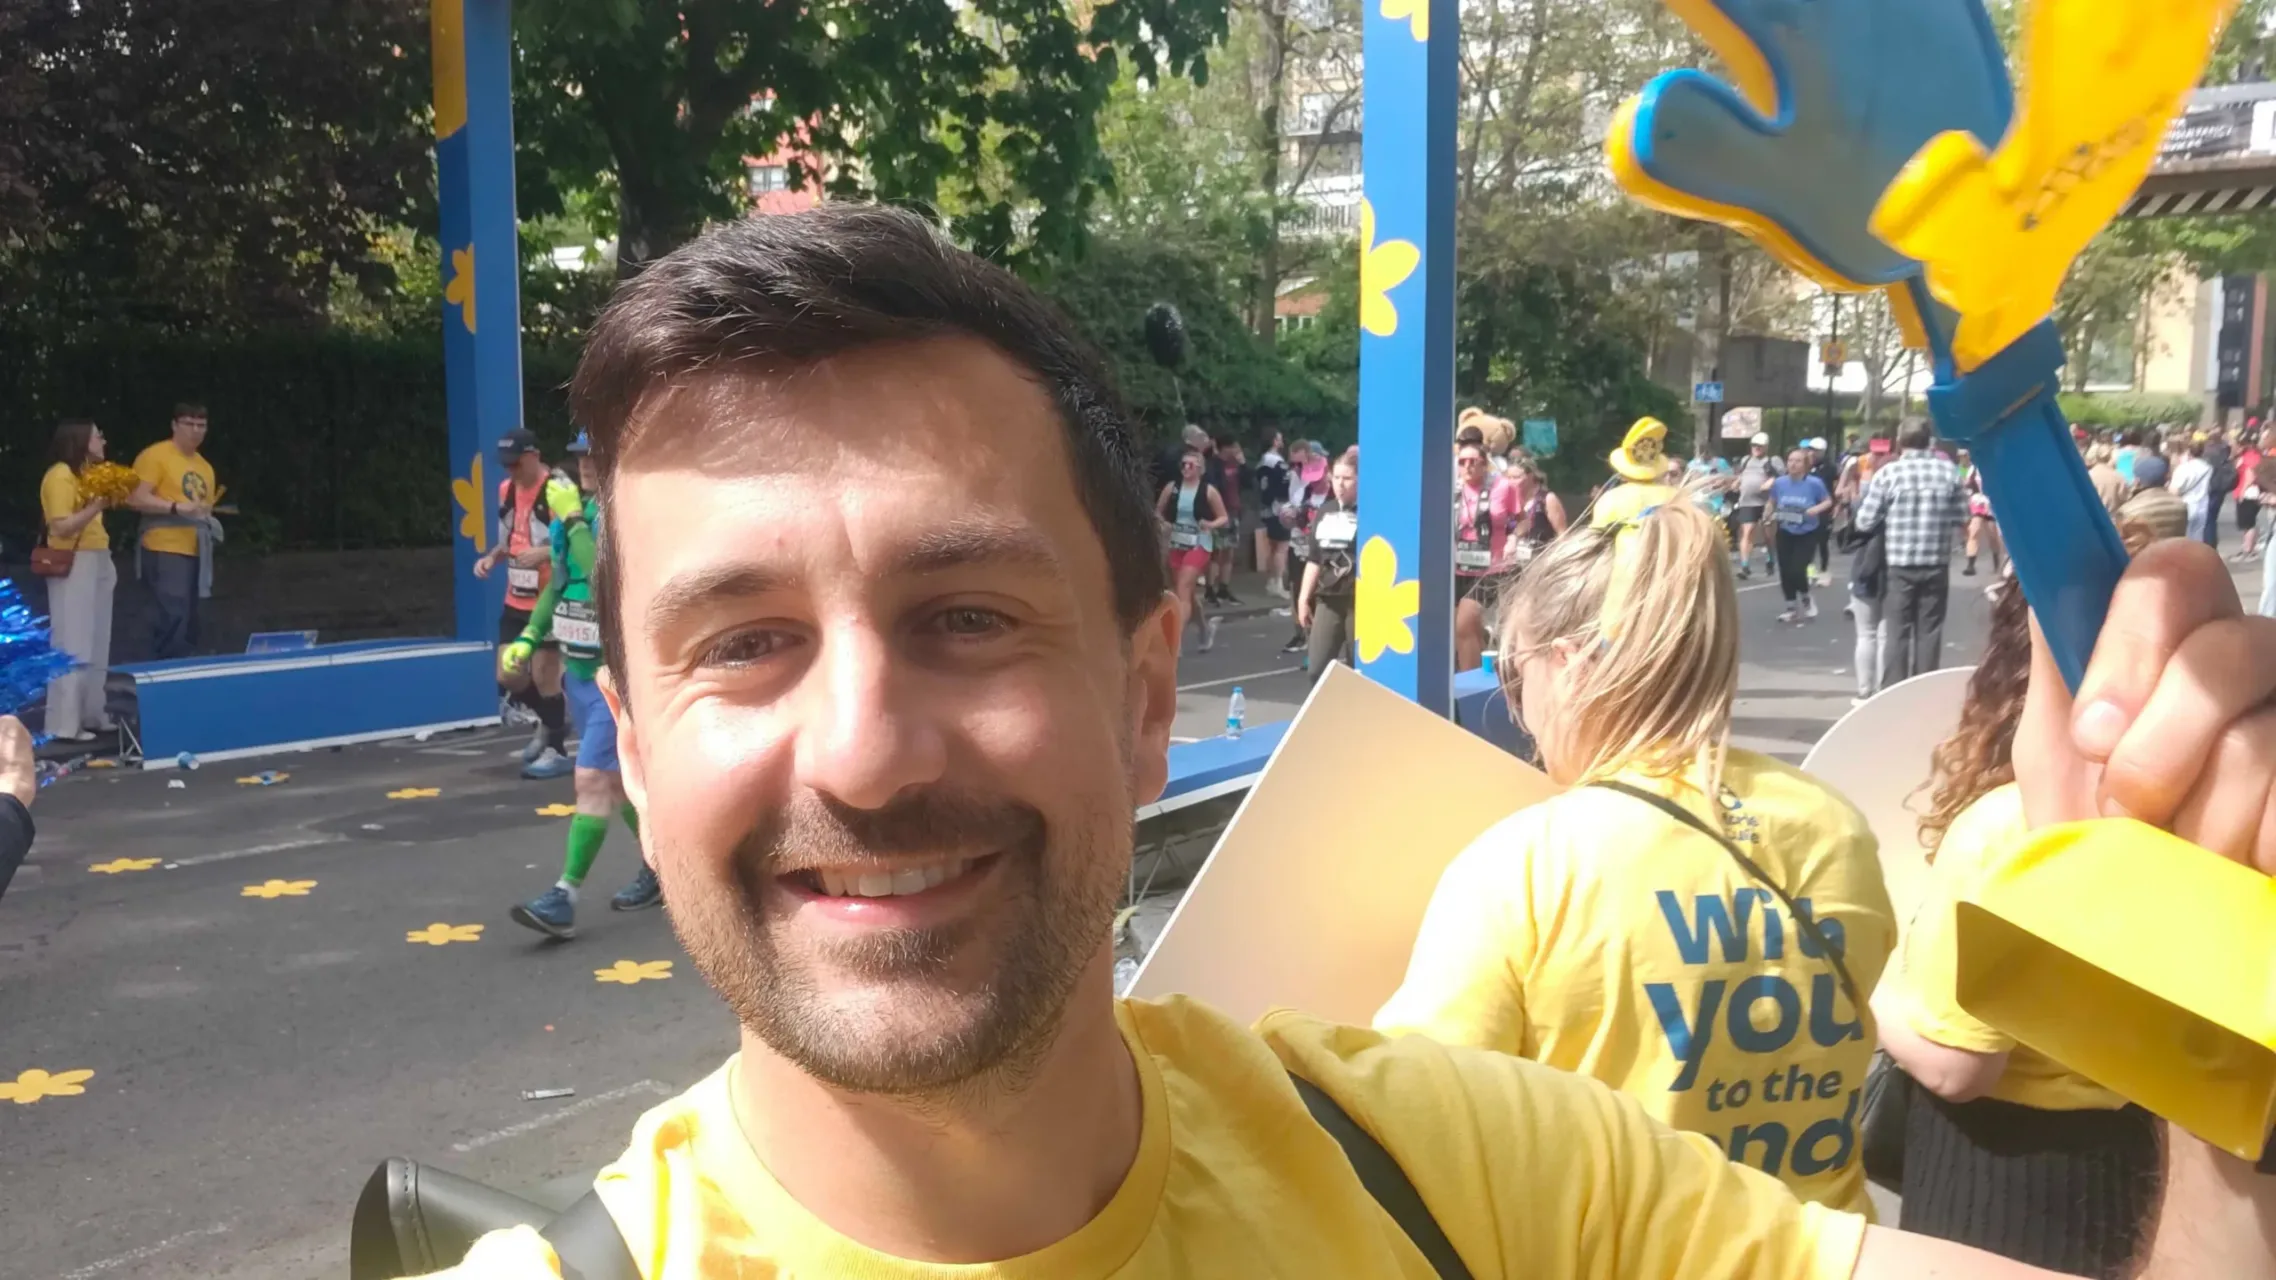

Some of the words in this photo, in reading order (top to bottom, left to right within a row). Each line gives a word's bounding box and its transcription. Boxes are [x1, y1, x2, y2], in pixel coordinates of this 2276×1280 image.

[1643, 974, 1863, 1092] you
[1705, 1086, 1861, 1176] nd
[1707, 1076, 1750, 1112] to
[1763, 1063, 1842, 1103] the
